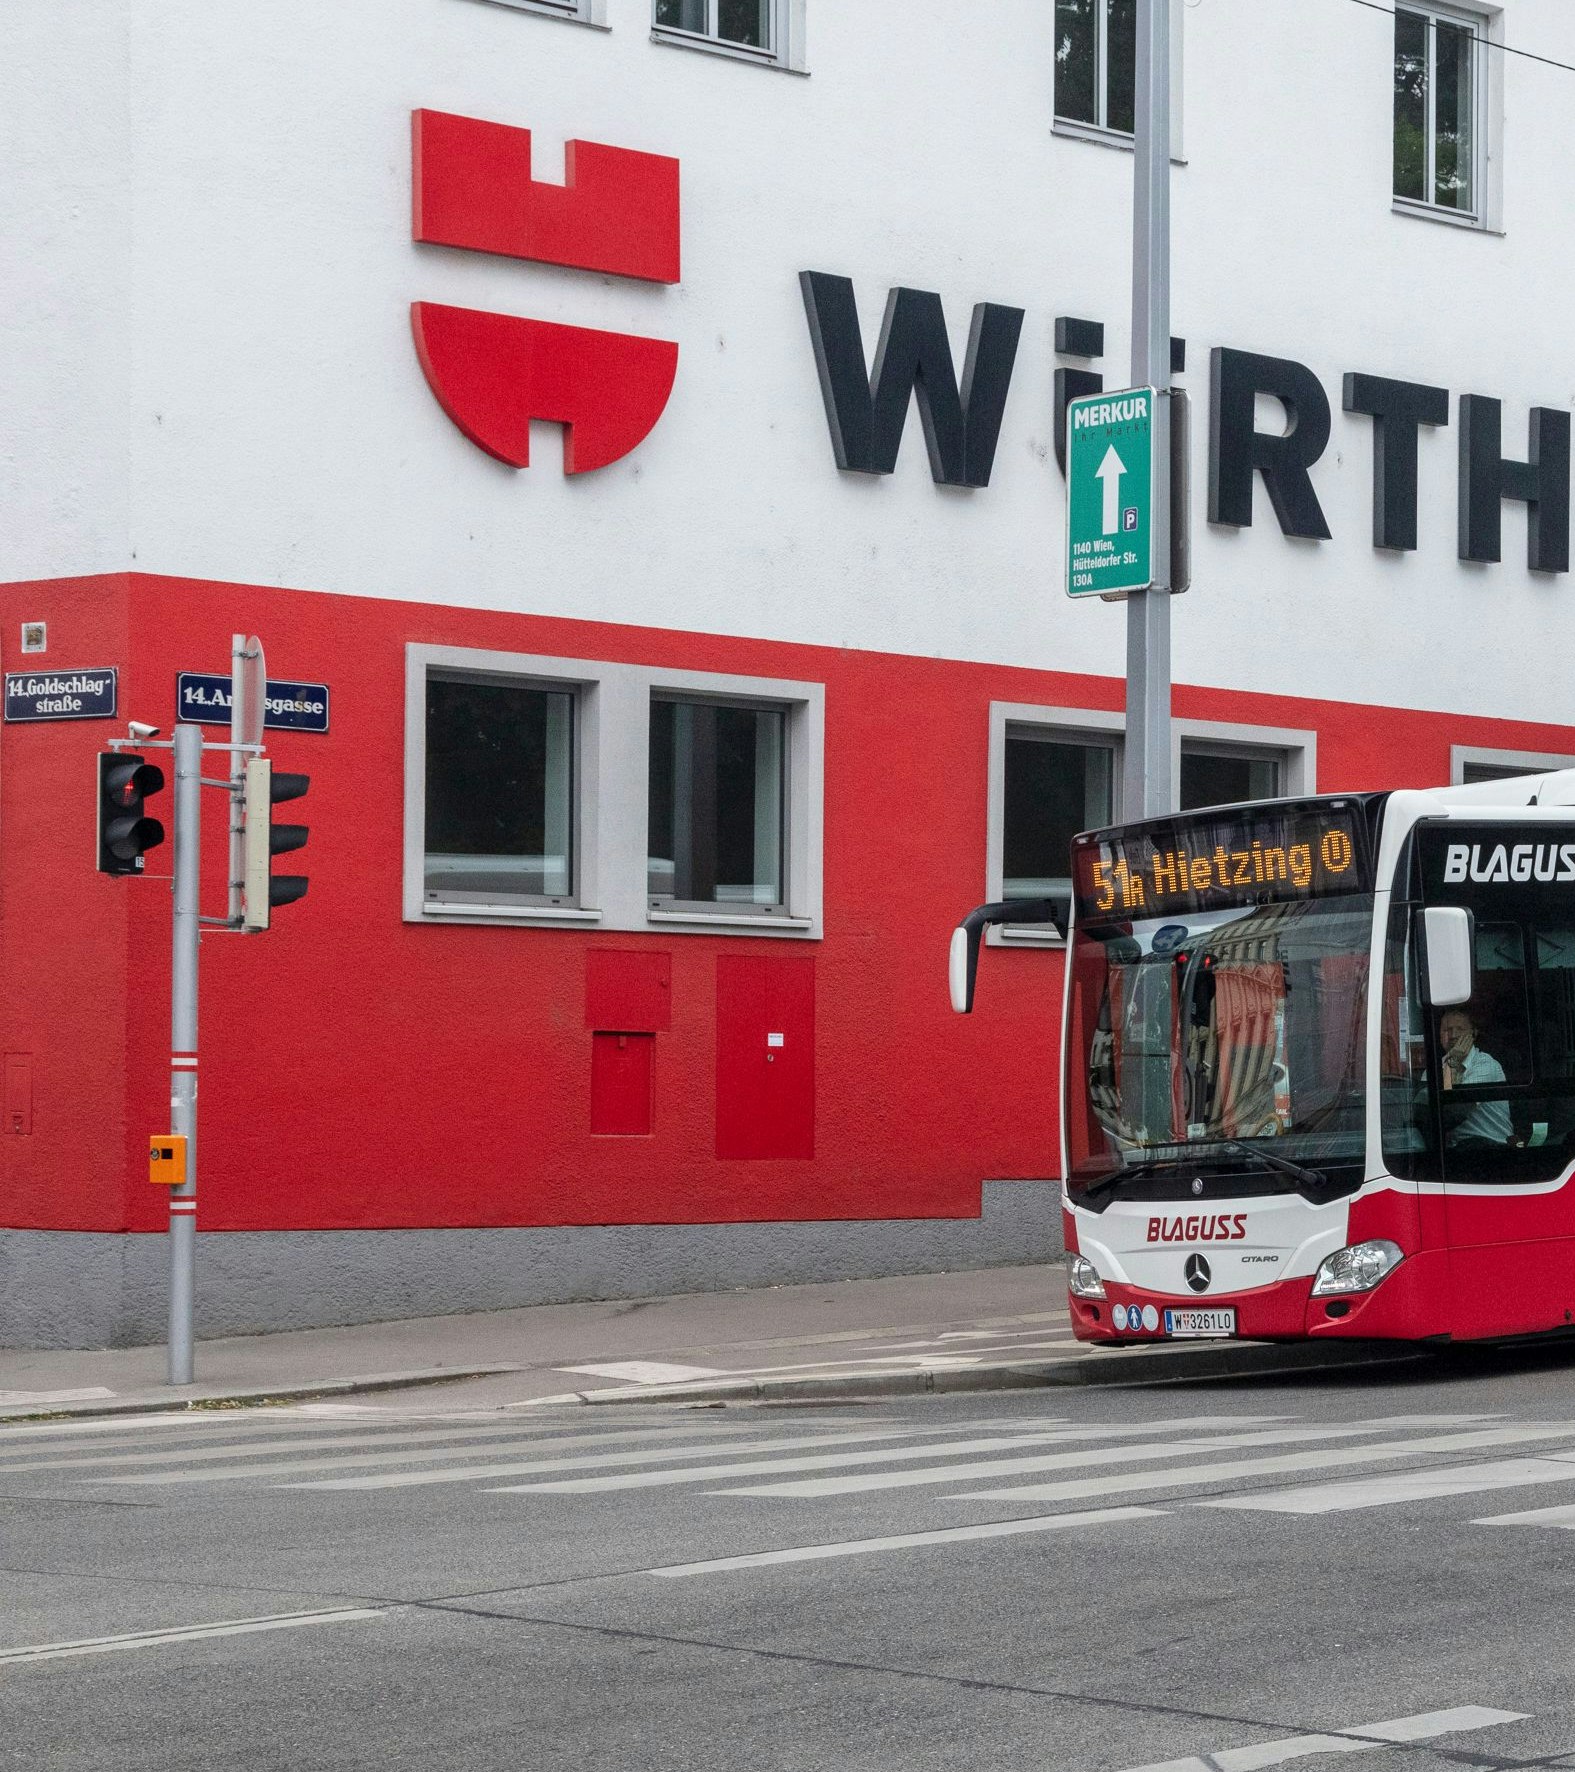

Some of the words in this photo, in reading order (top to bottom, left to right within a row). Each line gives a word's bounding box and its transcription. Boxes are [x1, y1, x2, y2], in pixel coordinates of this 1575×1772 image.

[1074, 397, 1147, 429] MERKUR
[1106, 422, 1148, 438] Markt
[1073, 542, 1091, 555] 1140
[1093, 539, 1115, 552] Wien,
[1073, 555, 1121, 571] Hütteldorfer
[1123, 552, 1138, 565] Str.
[1073, 573, 1093, 587] 130A
[36, 695, 82, 713] straße
[1092, 859, 1145, 910] 51A
[1152, 840, 1312, 894] Hietzing
[1147, 1213, 1248, 1243] BLAGUSS
[1241, 1255, 1279, 1263] CITARO
[1174, 1314, 1182, 1330] W
